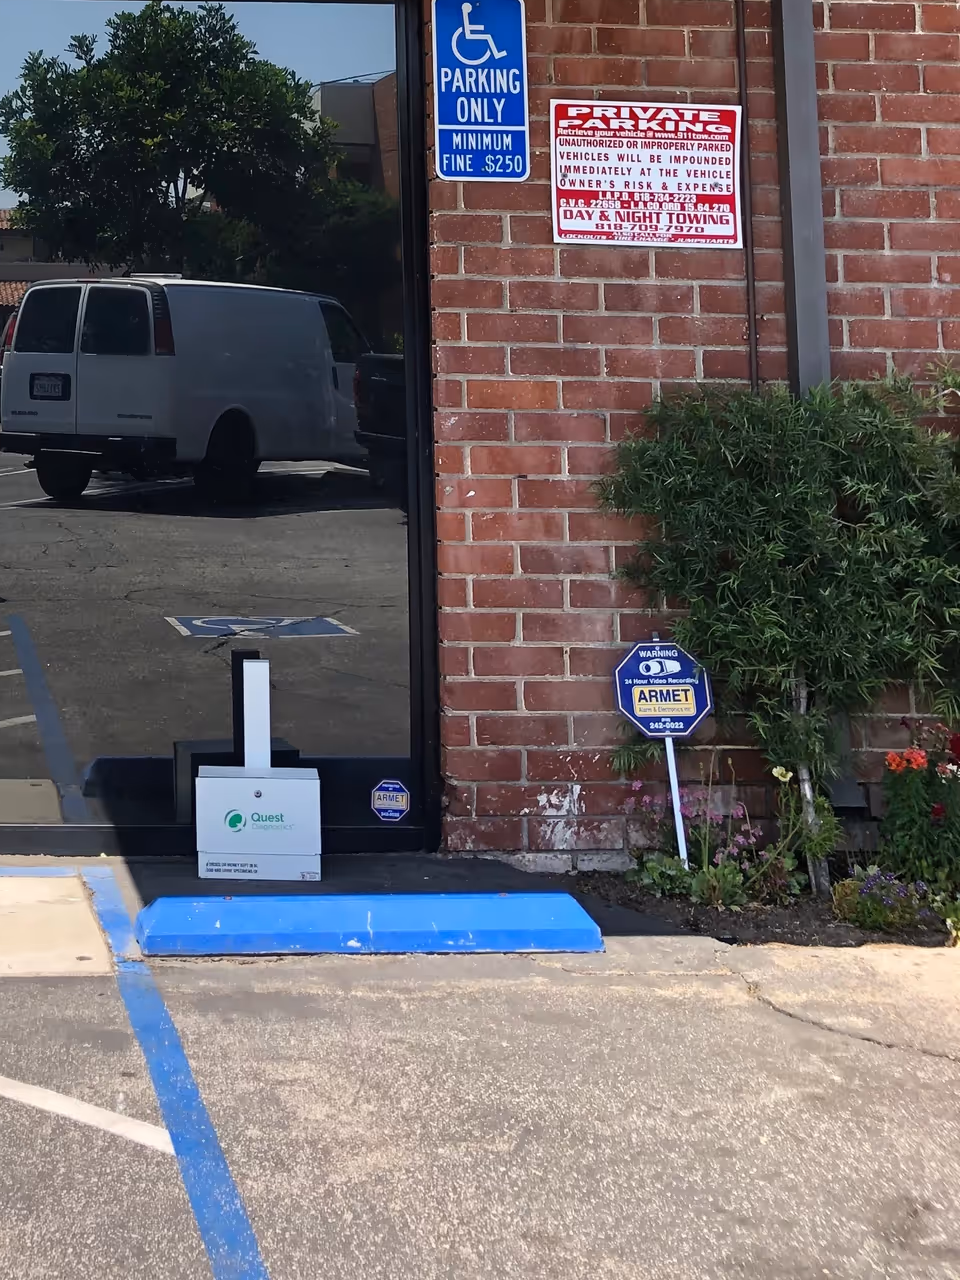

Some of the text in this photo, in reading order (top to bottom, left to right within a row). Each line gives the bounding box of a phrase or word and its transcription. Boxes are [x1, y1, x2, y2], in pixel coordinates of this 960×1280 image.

[440, 67, 520, 95] PARKING
[456, 96, 506, 123] ONLY
[567, 106, 721, 122] PRIVATE
[558, 118, 732, 133] PARKING
[452, 132, 512, 151] MINIMUM
[557, 127, 593, 136] Retrieve
[595, 130, 615, 138] your
[616, 129, 645, 138] vehicle
[655, 131, 729, 141] www.911tow.com
[559, 138, 731, 153] UNAUTHORIZED OR IMPROPERLY PARKED
[442, 153, 523, 174] FINE $250
[559, 151, 731, 166] VEHICLES WILL BE IMPOUNDED
[559, 164, 731, 180] IMMEDIATELY AT THE VEHICLE
[560, 178, 732, 193] OWNER'S RISK & EXPENSE
[598, 191, 697, 203] L.A.P.D. 818-734-2223
[560, 198, 587, 207] C.V.C.
[590, 199, 621, 209] 22658
[683, 203, 730, 213] 15.64.270
[563, 209, 730, 225] DAY & NIGHT TOWING
[595, 223, 705, 233] 818-709-7970
[638, 688, 691, 703] ARMET
[649, 721, 684, 729] 242-0022
[376, 793, 405, 803] ARMET
[251, 812, 285, 823] Quest
